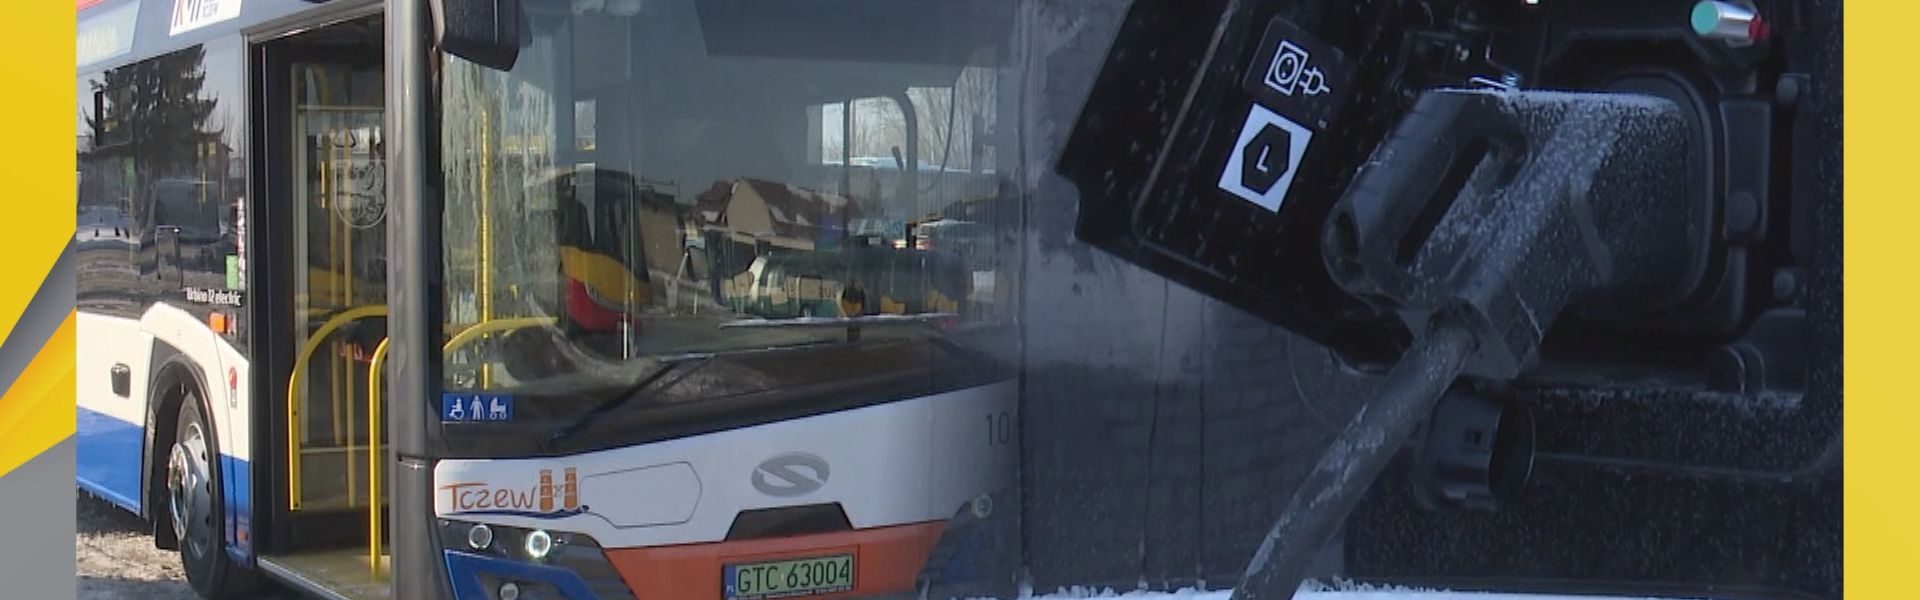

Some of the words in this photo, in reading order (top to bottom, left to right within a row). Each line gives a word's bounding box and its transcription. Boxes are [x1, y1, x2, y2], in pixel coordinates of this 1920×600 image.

[1256, 144, 1270, 172] L
[985, 411, 1010, 446] 10
[439, 481, 538, 512] Tczew
[738, 565, 779, 593] GTC
[786, 559, 850, 589] 63004
